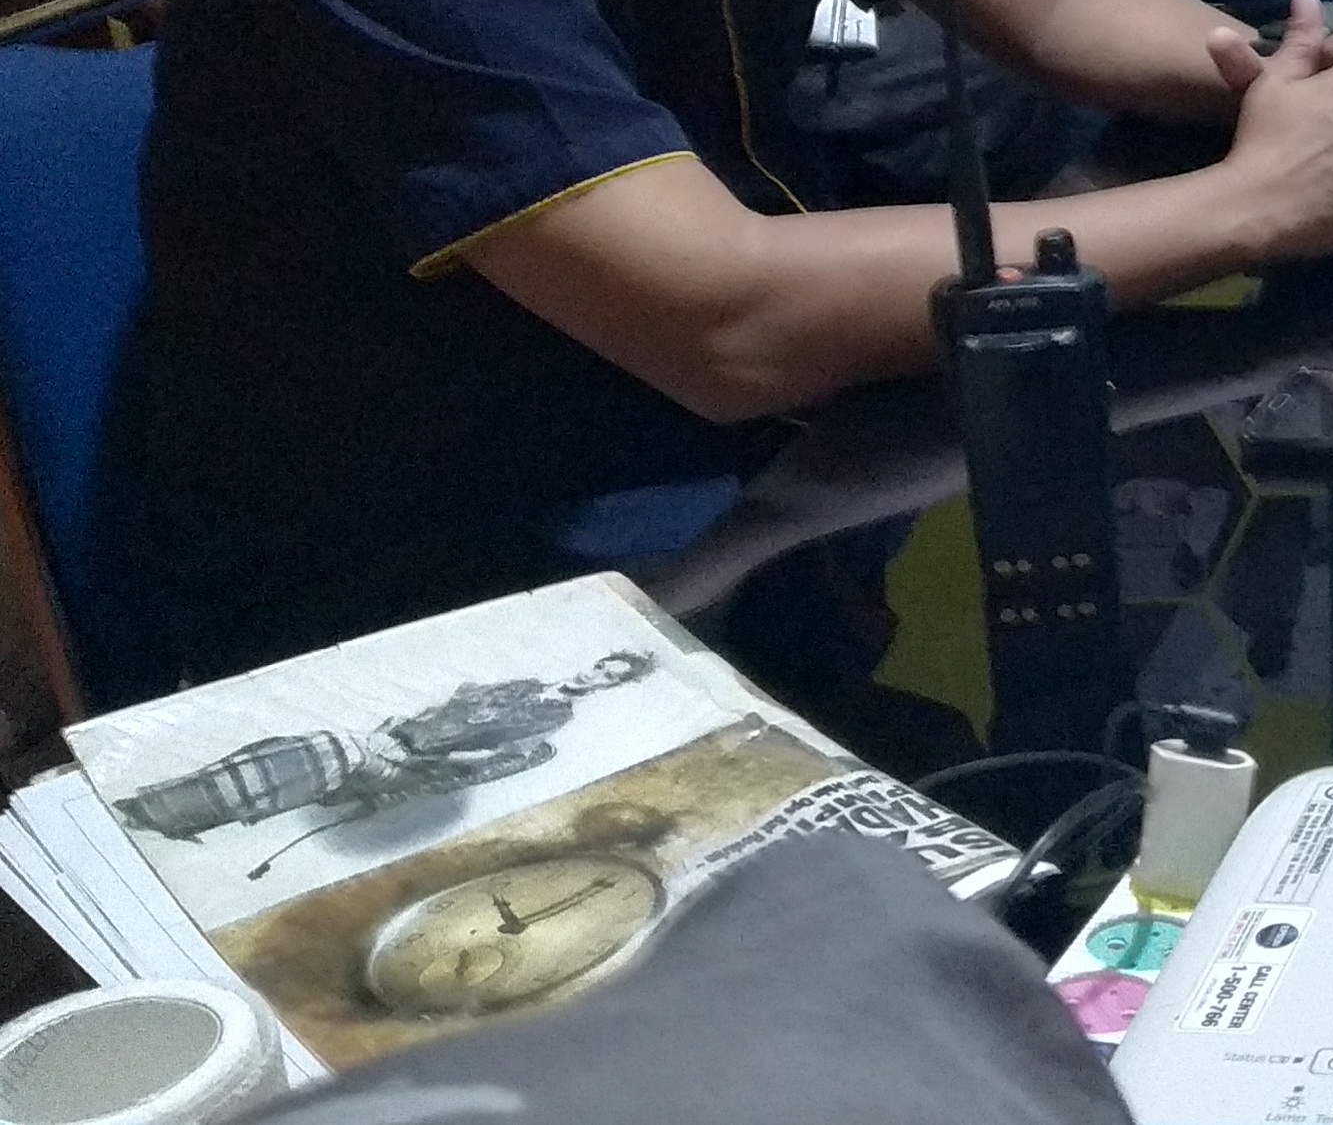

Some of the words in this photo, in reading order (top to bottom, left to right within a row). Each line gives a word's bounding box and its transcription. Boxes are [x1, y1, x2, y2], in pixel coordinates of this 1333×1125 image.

[1201, 965, 1248, 1028] 1-500-766
[1248, 966, 1272, 989] CALL
[1228, 991, 1259, 1029] CENTER
